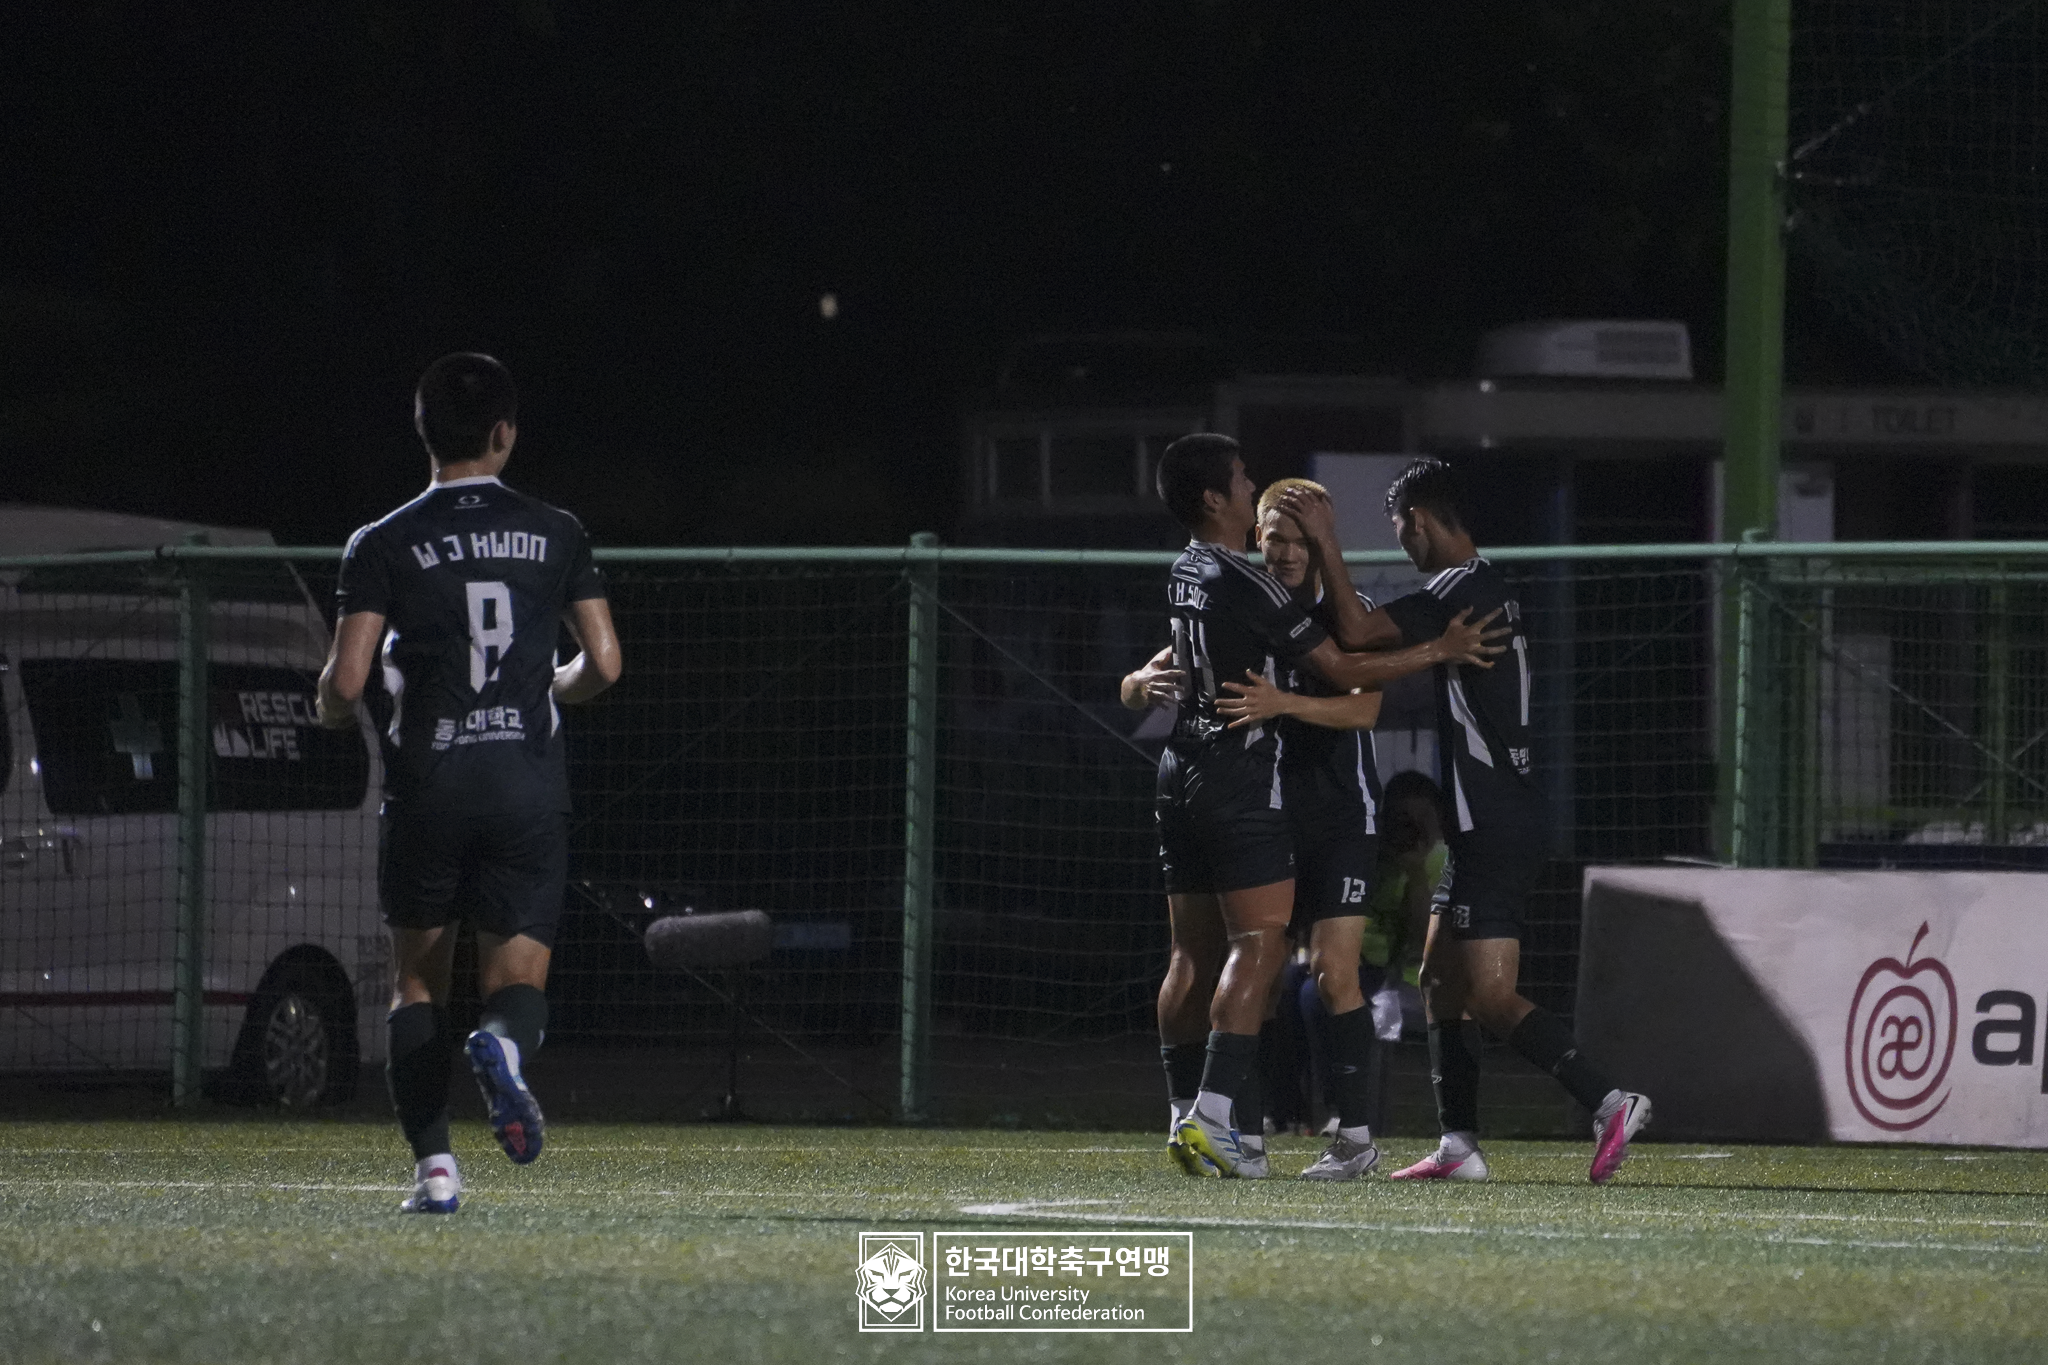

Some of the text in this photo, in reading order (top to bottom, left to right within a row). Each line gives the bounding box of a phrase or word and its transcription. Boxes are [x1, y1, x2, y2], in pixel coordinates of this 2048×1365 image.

[411, 531, 546, 570] W J KWON
[465, 581, 514, 694] 8
[238, 691, 320, 727] RESCU
[248, 726, 300, 761] LIFE
